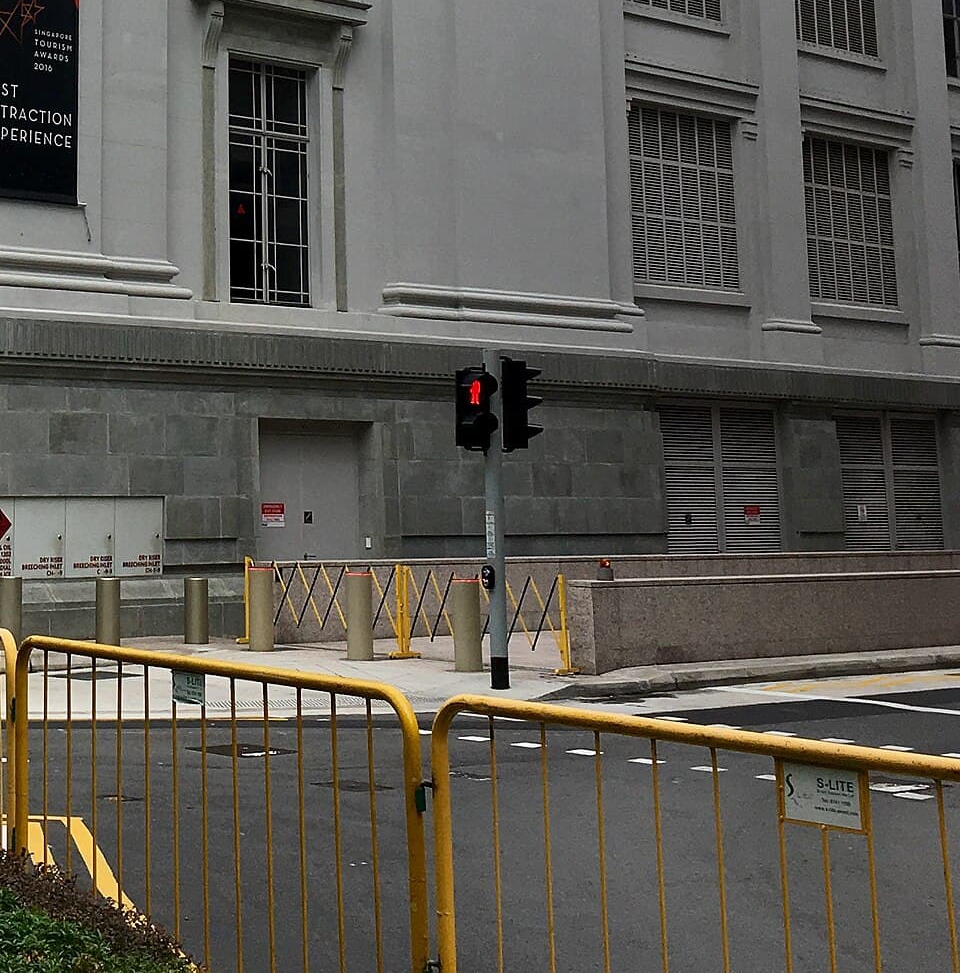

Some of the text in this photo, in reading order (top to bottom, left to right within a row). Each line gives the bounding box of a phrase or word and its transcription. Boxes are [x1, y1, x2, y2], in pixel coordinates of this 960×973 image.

[34, 28, 72, 41] SINGAPORE
[34, 38, 73, 52] TOURISM
[33, 50, 69, 63] AWARDS
[33, 62, 53, 73] 2016
[816, 777, 854, 793] S-LITE
